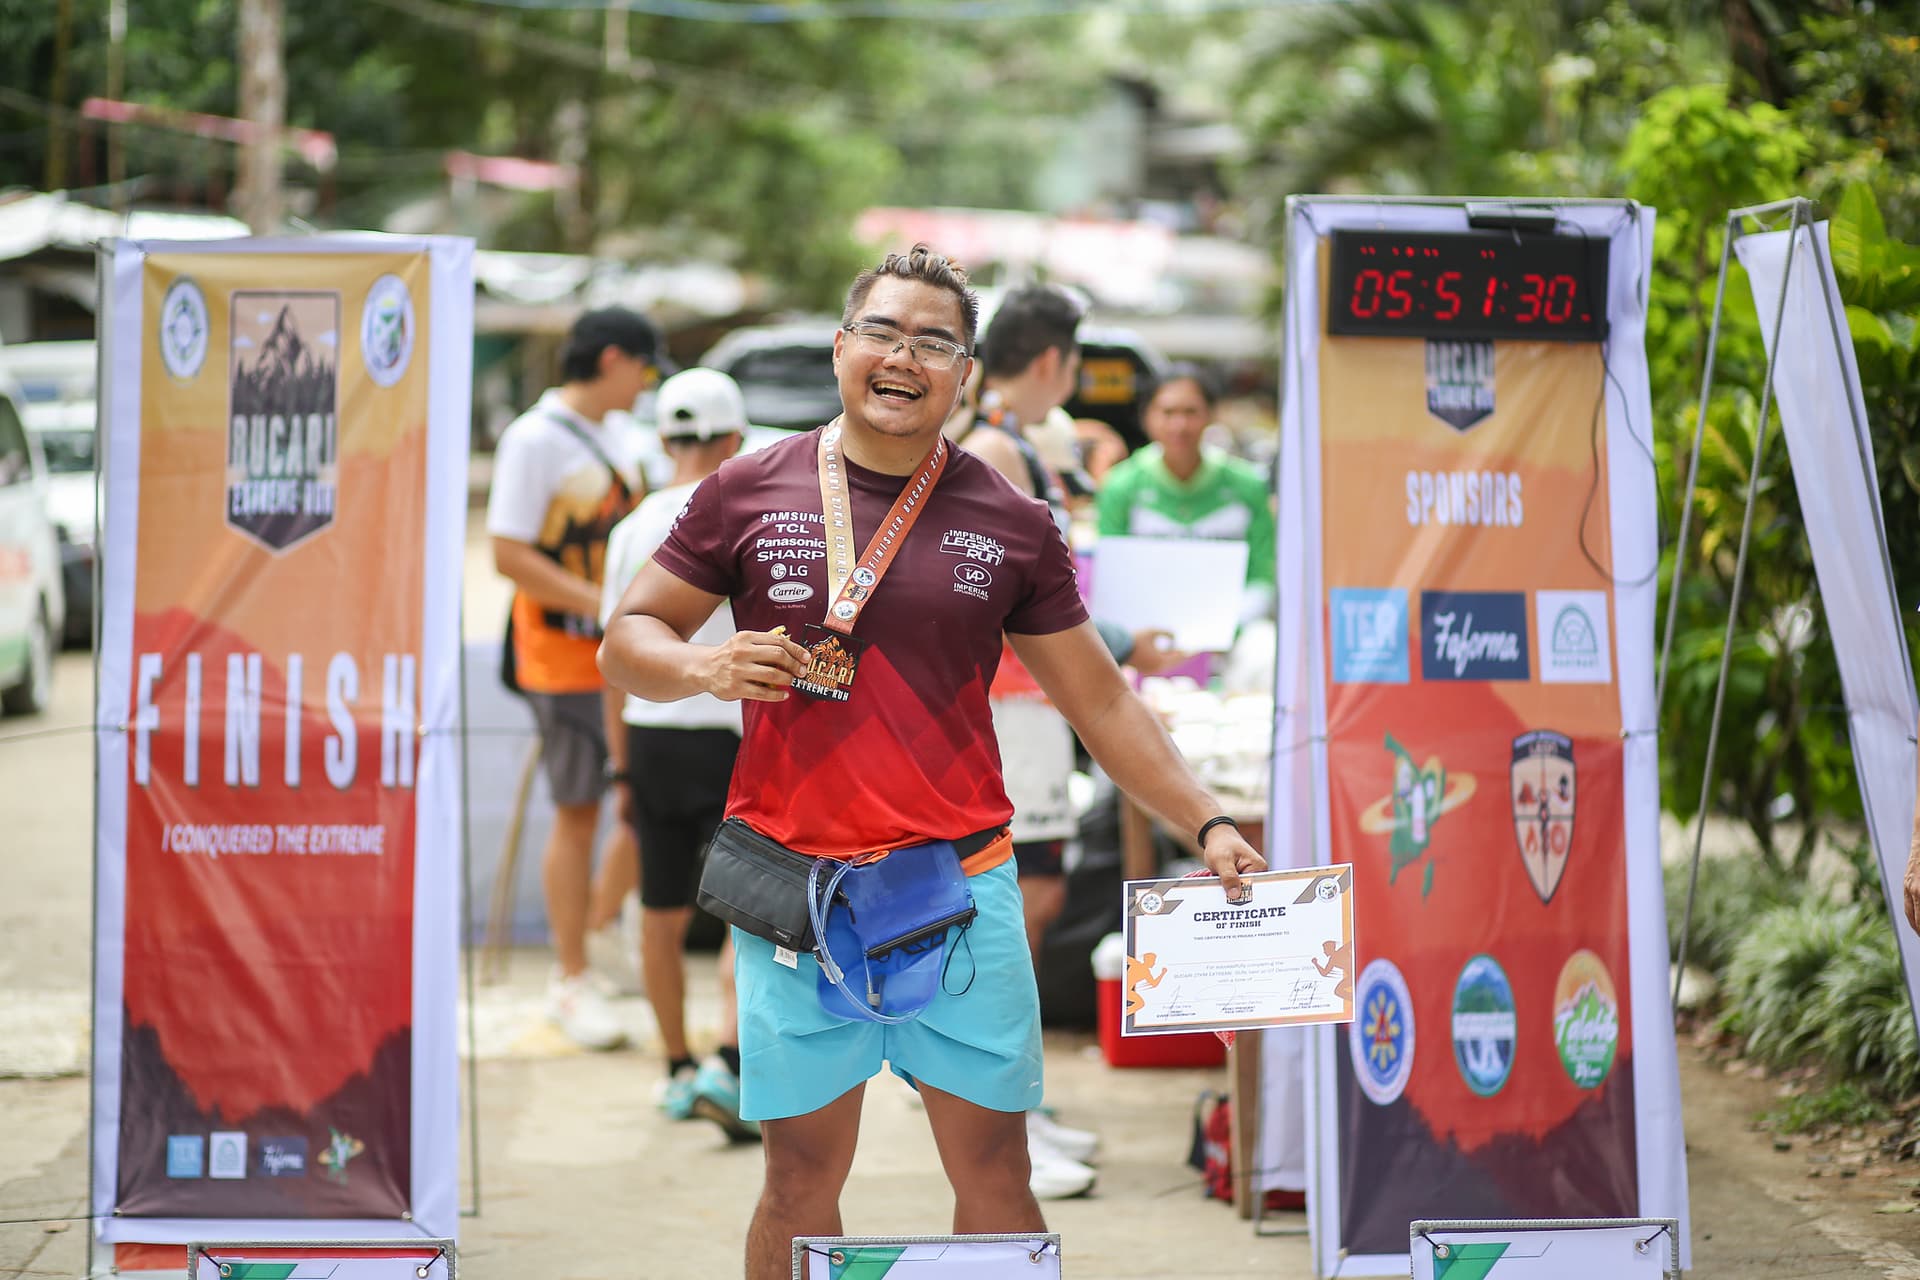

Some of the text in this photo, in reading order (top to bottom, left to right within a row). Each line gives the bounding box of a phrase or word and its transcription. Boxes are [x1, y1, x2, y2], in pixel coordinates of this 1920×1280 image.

[1406, 470, 1523, 526] SPONSORS
[868, 515, 905, 569] FINISHER
[902, 471, 931, 513] BUCARI
[775, 523, 810, 534] TCL
[756, 537, 827, 549] Panasonic
[949, 529, 999, 547] IMPERIAL
[757, 549, 826, 562] SHARP
[789, 564, 809, 577] LG
[773, 587, 808, 598] Carrier
[953, 582, 989, 598] IMPERIAL
[806, 658, 855, 686] UCARI
[791, 678, 849, 701] EXTREME RUN
[134, 652, 416, 789] FINISH
[162, 824, 385, 859] I CONQUERED THE EXTREME
[1194, 907, 1286, 922] CERTIFICATE
[1230, 920, 1261, 929] FINISH
